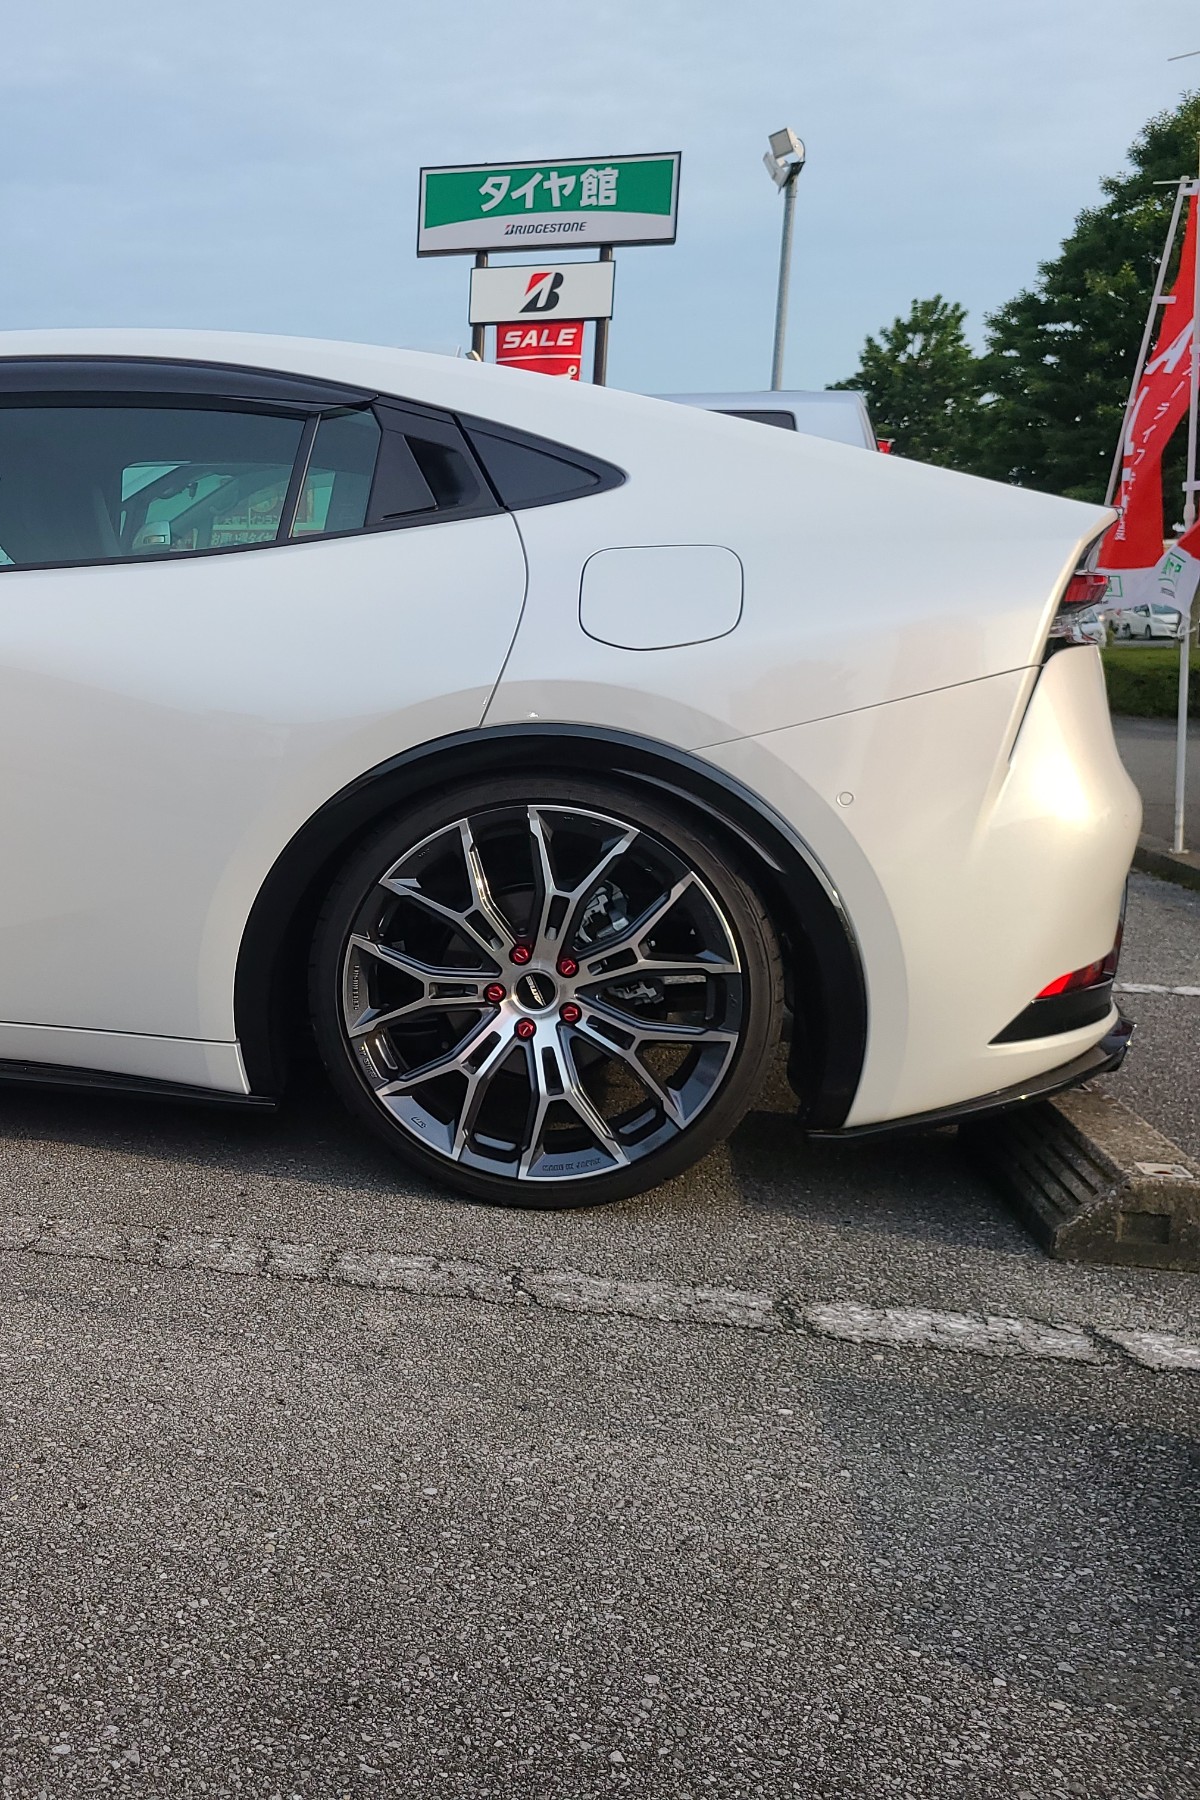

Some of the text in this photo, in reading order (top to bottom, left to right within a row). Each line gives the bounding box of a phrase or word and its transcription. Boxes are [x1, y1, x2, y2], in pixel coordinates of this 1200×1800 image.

[478, 167, 619, 213] タイヤ館
[504, 222, 587, 236] BRIDGESTONE
[502, 328, 578, 349] SALE
